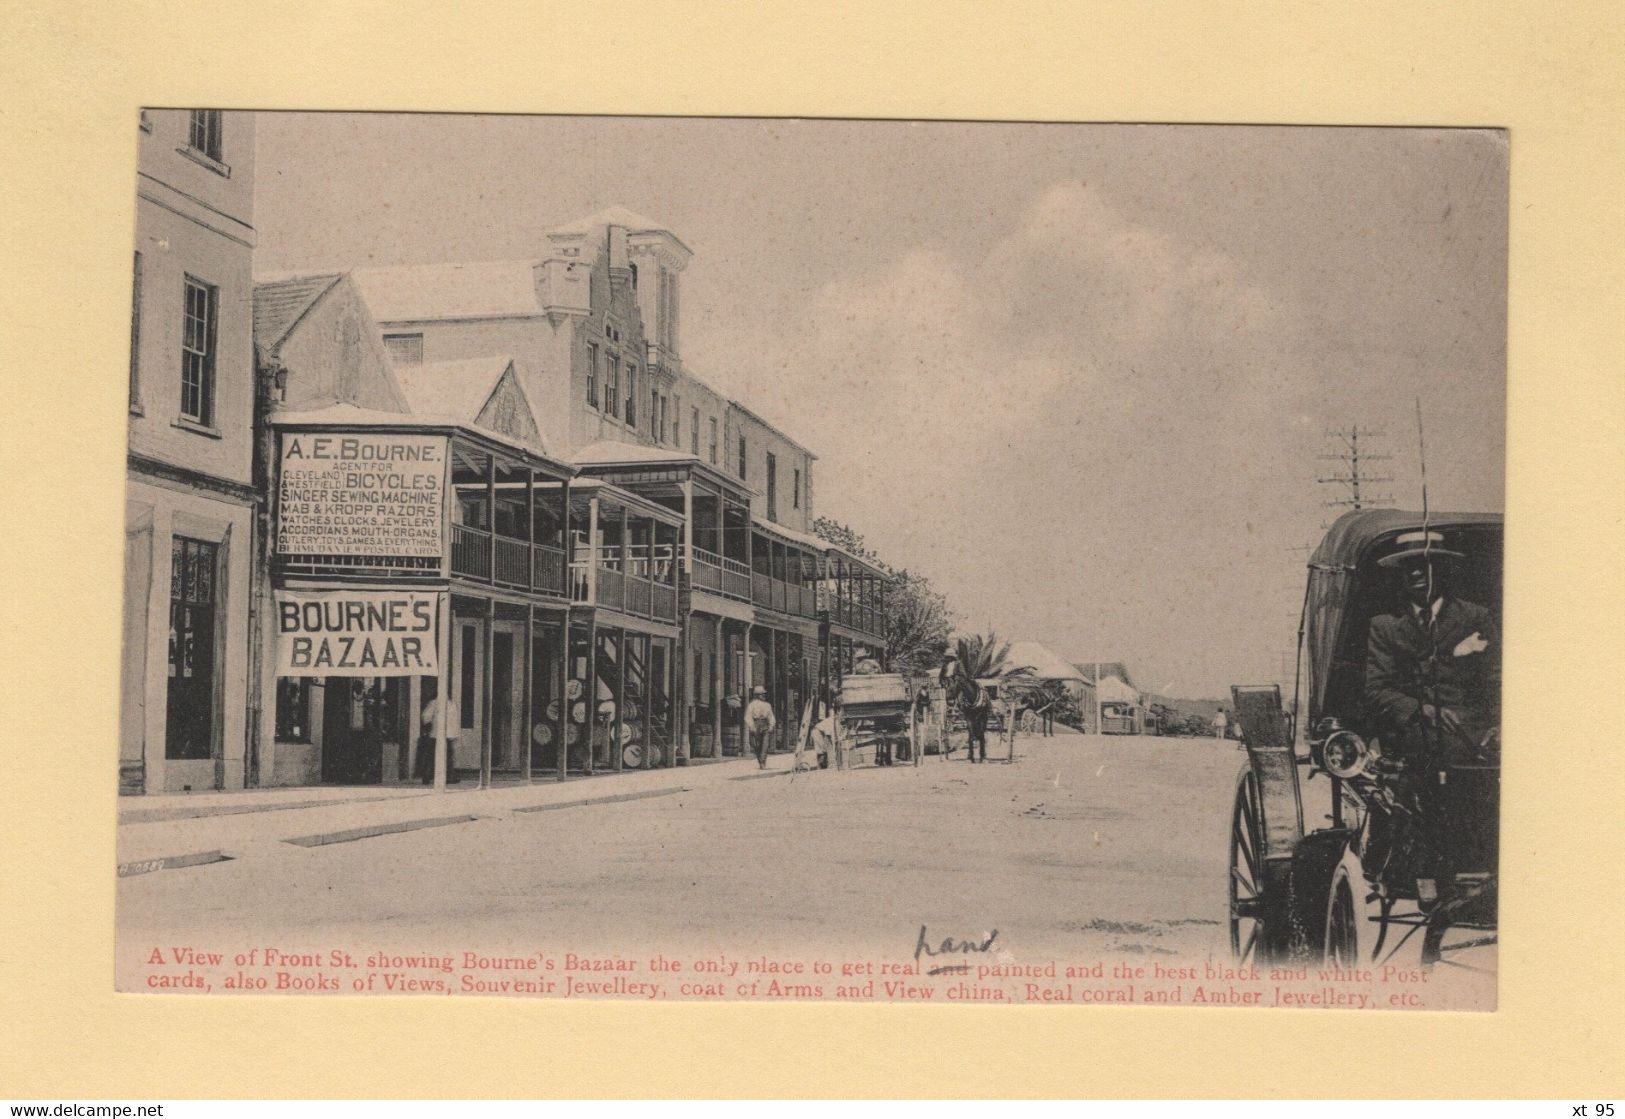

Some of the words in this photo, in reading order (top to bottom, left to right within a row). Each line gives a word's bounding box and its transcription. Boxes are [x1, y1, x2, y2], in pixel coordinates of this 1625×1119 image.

[333, 462, 368, 471] AGENT
[371, 463, 392, 472] FOR
[346, 473, 441, 491] BICYCLES.
[281, 489, 329, 503] SINGER
[331, 490, 379, 504] SEWING
[281, 503, 310, 514] MAB
[313, 504, 322, 514] &
[325, 504, 373, 516] KROPP
[279, 595, 430, 632] BOURNE'S
[290, 637, 432, 668] BAZAAR.
[914, 925, 998, 960] hand
